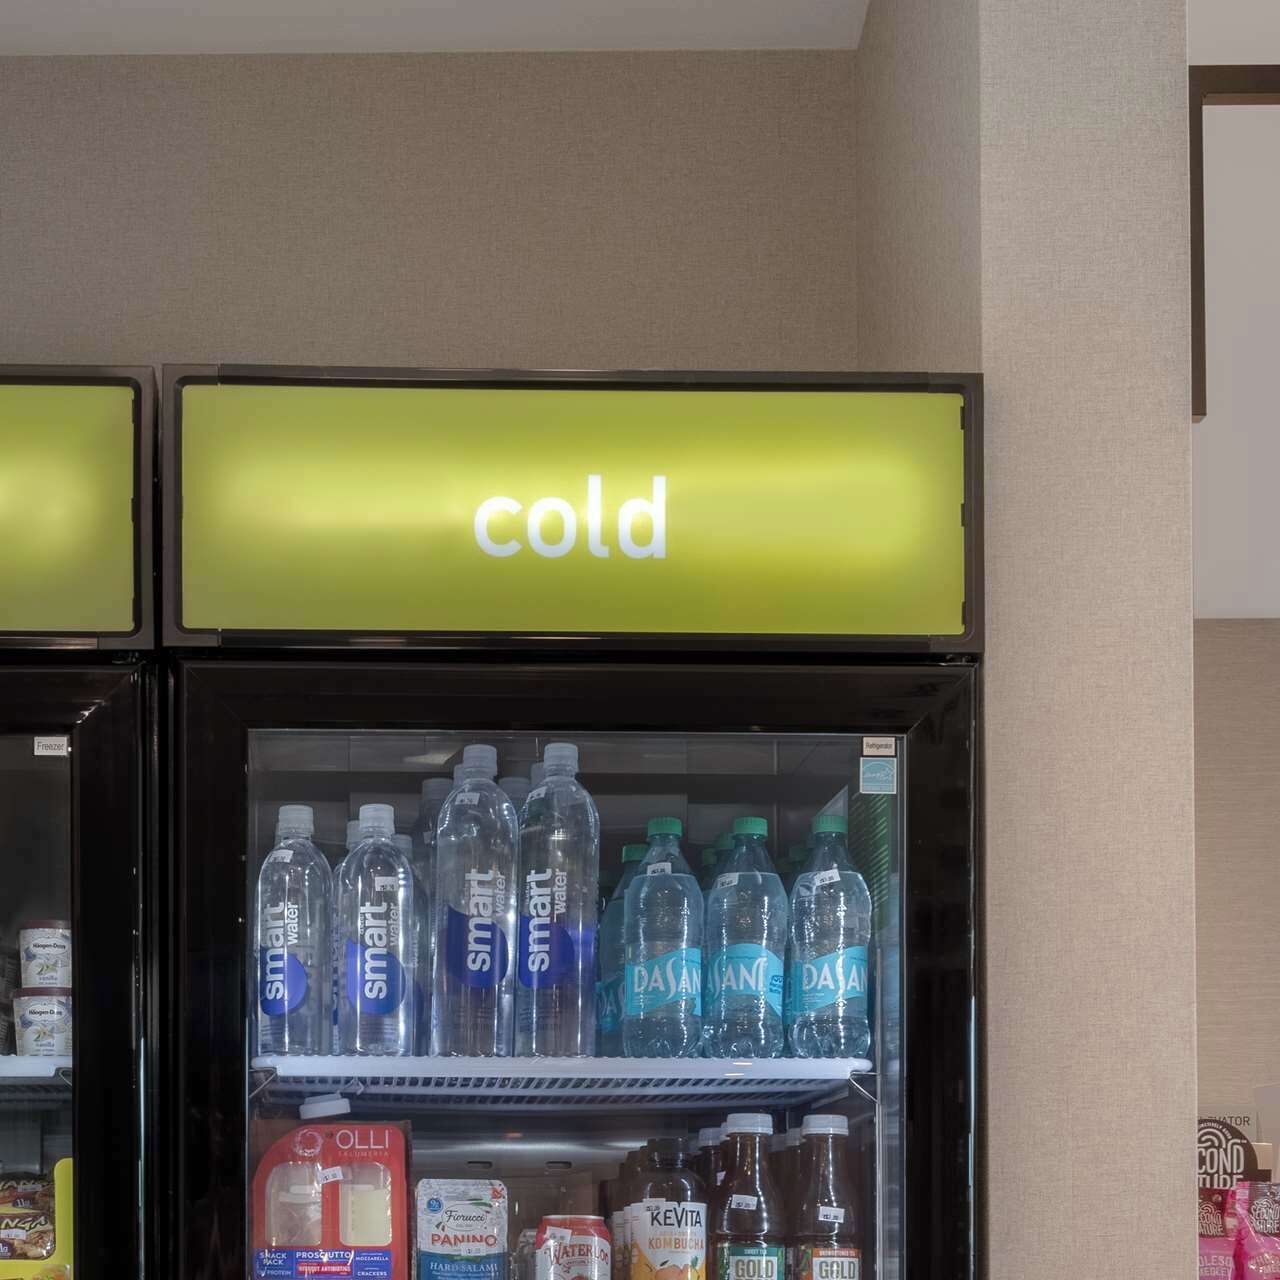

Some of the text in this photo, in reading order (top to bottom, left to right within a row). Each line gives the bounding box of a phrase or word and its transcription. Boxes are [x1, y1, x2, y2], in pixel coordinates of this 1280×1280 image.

[473, 473, 668, 560] cold
[554, 869, 567, 915] water
[286, 902, 299, 945] water
[465, 868, 494, 972] smart
[526, 868, 552, 972] smart
[363, 901, 387, 1000] smart
[336, 1129, 390, 1149] OLLI
[445, 1210, 485, 1223] Fiorucci
[431, 1233, 497, 1249] PANINO
[648, 1237, 704, 1249] KOMBUCHA
[735, 1260, 774, 1278] GOLD
[819, 1261, 855, 1279] GOLD
